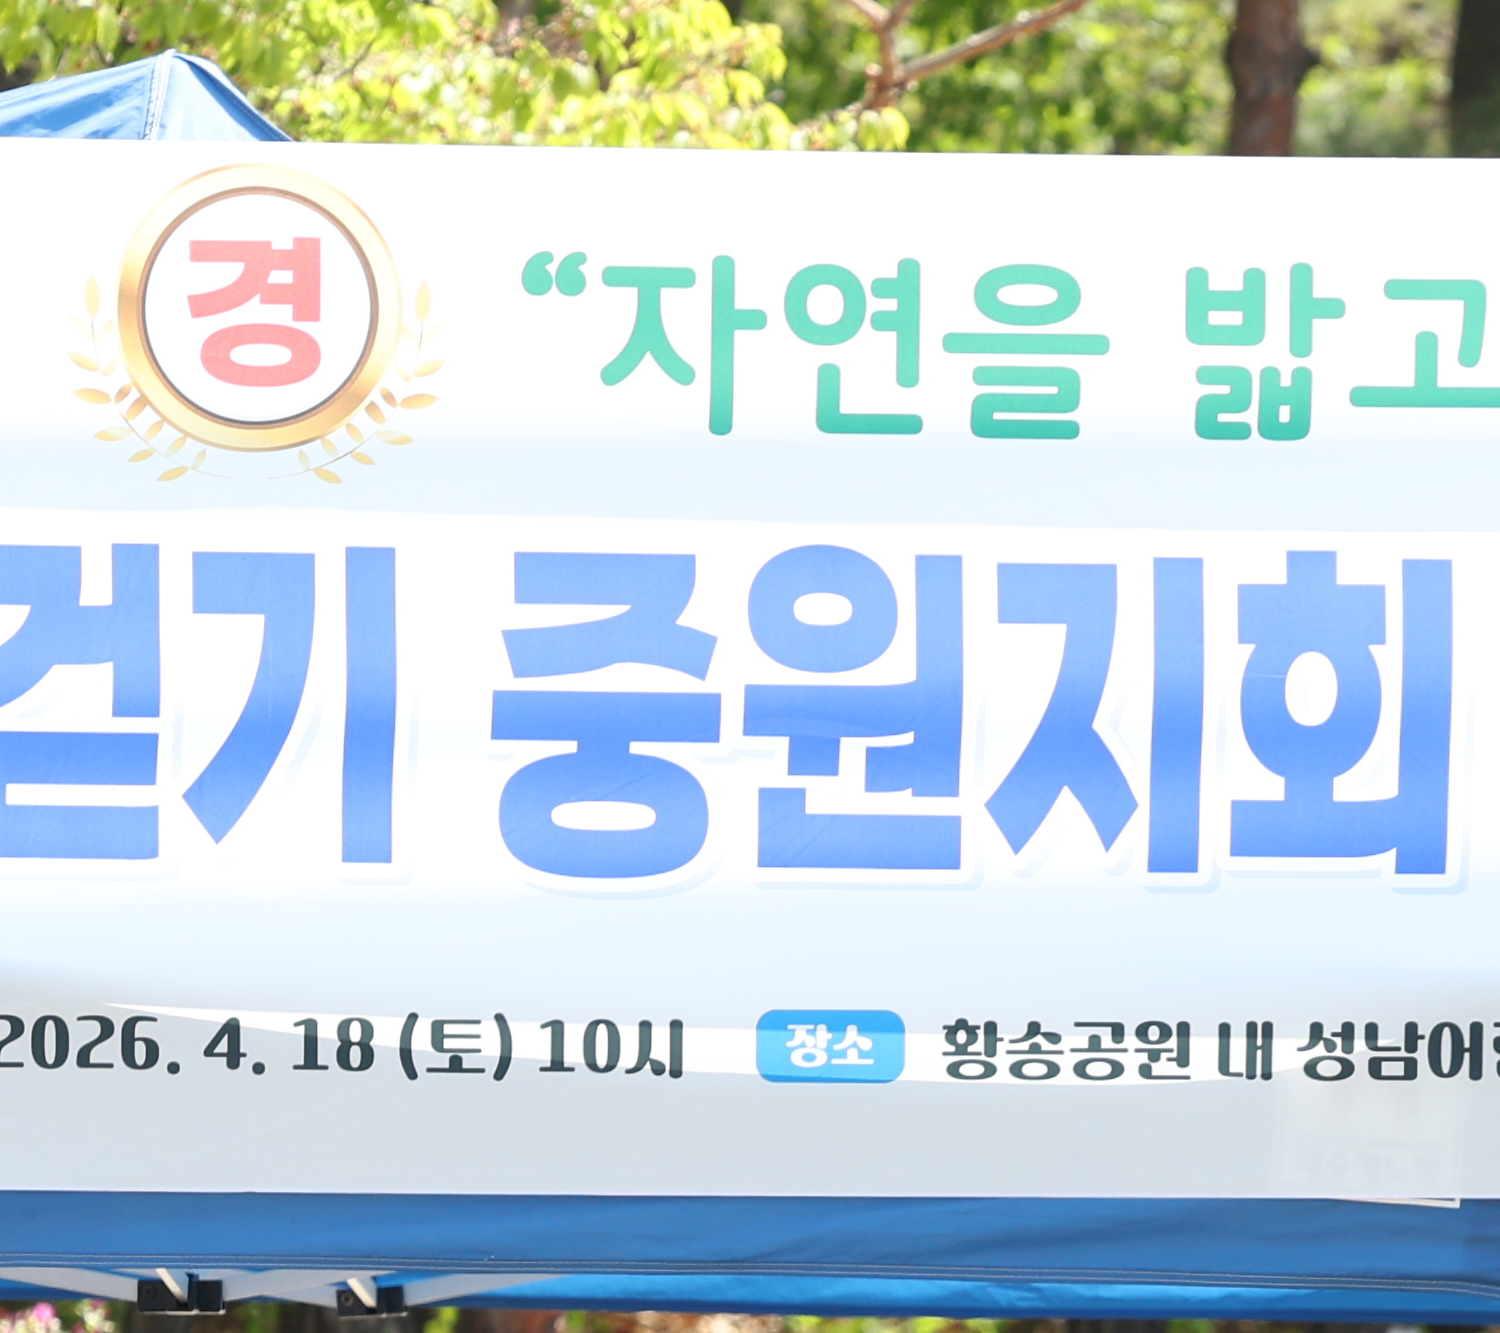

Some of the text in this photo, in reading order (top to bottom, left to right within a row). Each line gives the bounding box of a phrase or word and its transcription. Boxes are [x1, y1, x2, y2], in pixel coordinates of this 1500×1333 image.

[187, 236, 322, 388] 경
[524, 252, 1109, 439] “자연을
[491, 545, 1452, 878] 중원지회
[204, 1018, 265, 1074] 4.
[293, 1019, 374, 1071] 18
[400, 1013, 511, 1081] (토)
[540, 1020, 683, 1078] 10시
[784, 1022, 876, 1069] 장소
[944, 1019, 1190, 1080] 황송공원
[1219, 1022, 1273, 1080] 내
